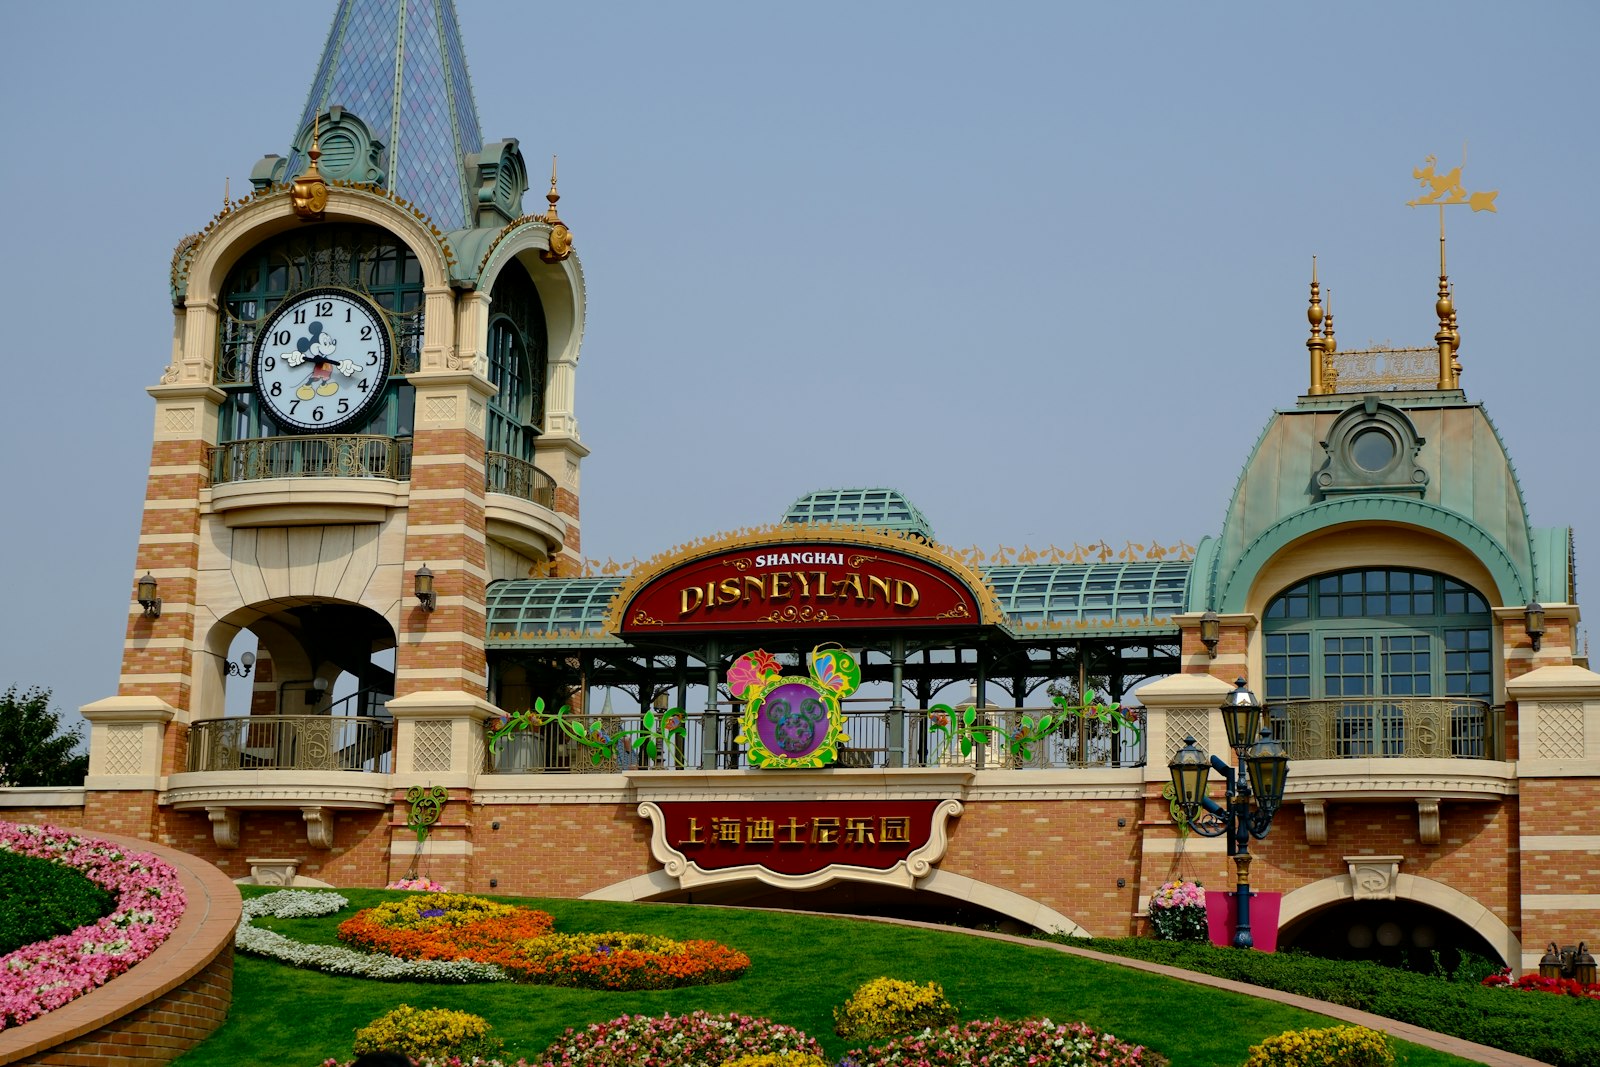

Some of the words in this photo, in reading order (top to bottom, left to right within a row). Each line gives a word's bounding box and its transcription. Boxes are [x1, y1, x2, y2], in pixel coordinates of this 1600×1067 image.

[293, 309, 306, 324] 11
[315, 302, 333, 317] 12
[345, 308, 351, 322] 1
[272, 330, 291, 346] 10
[360, 325, 372, 341] 2
[264, 357, 275, 371] 9
[366, 351, 378, 366] 3
[270, 381, 282, 397] 8
[357, 378, 369, 392] 4
[289, 400, 301, 415] 7
[312, 406, 324, 421] 6
[337, 398, 349, 414] 5
[755, 552, 844, 568] SHANGHAI
[679, 571, 920, 616] DISNEYLAND
[678, 816, 911, 844] 上海迪士尼乐园
